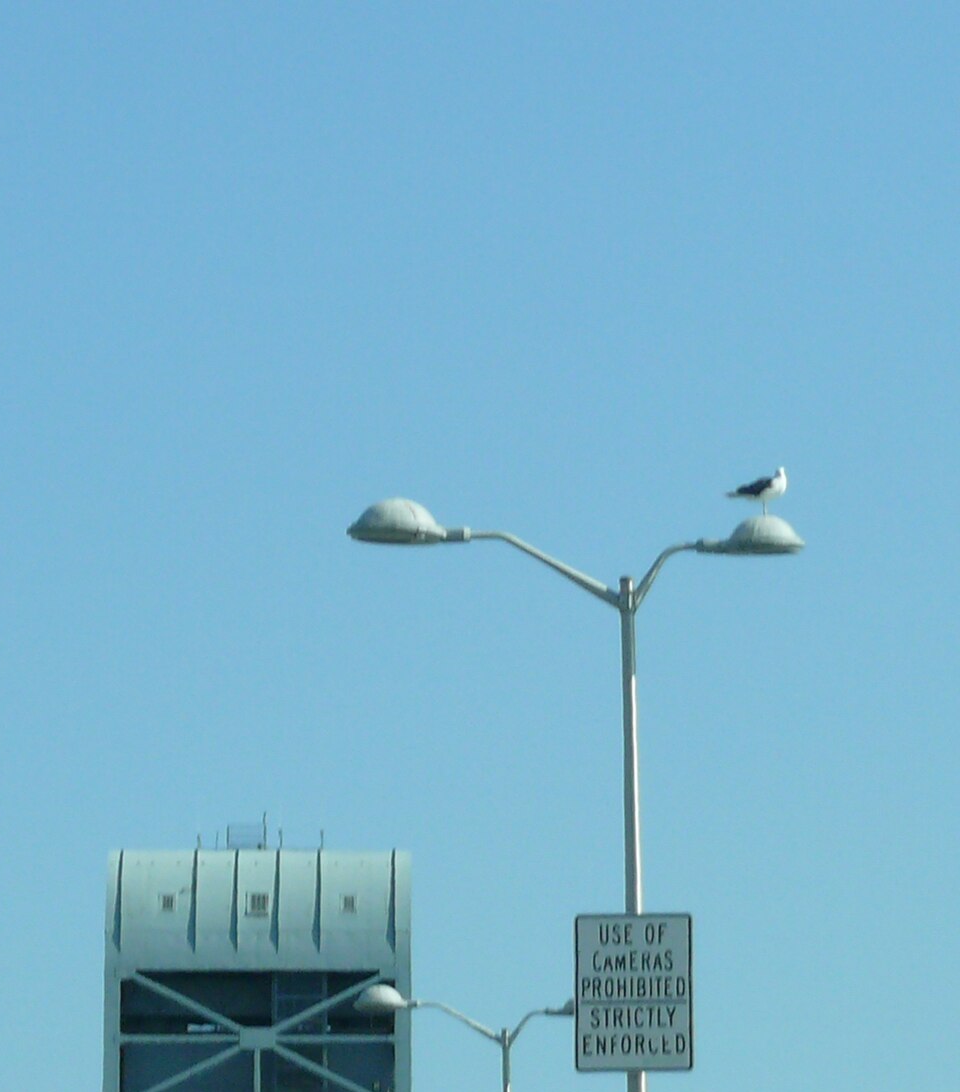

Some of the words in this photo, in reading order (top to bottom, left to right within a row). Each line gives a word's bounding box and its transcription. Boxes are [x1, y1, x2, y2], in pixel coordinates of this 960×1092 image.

[599, 922, 633, 945] USE
[644, 922, 668, 945] OF
[592, 949, 673, 972] CAMERAS
[581, 977, 686, 998] PROHIBITED
[590, 1006, 676, 1029] STRICTLY
[582, 1033, 686, 1056] ENFORCED
